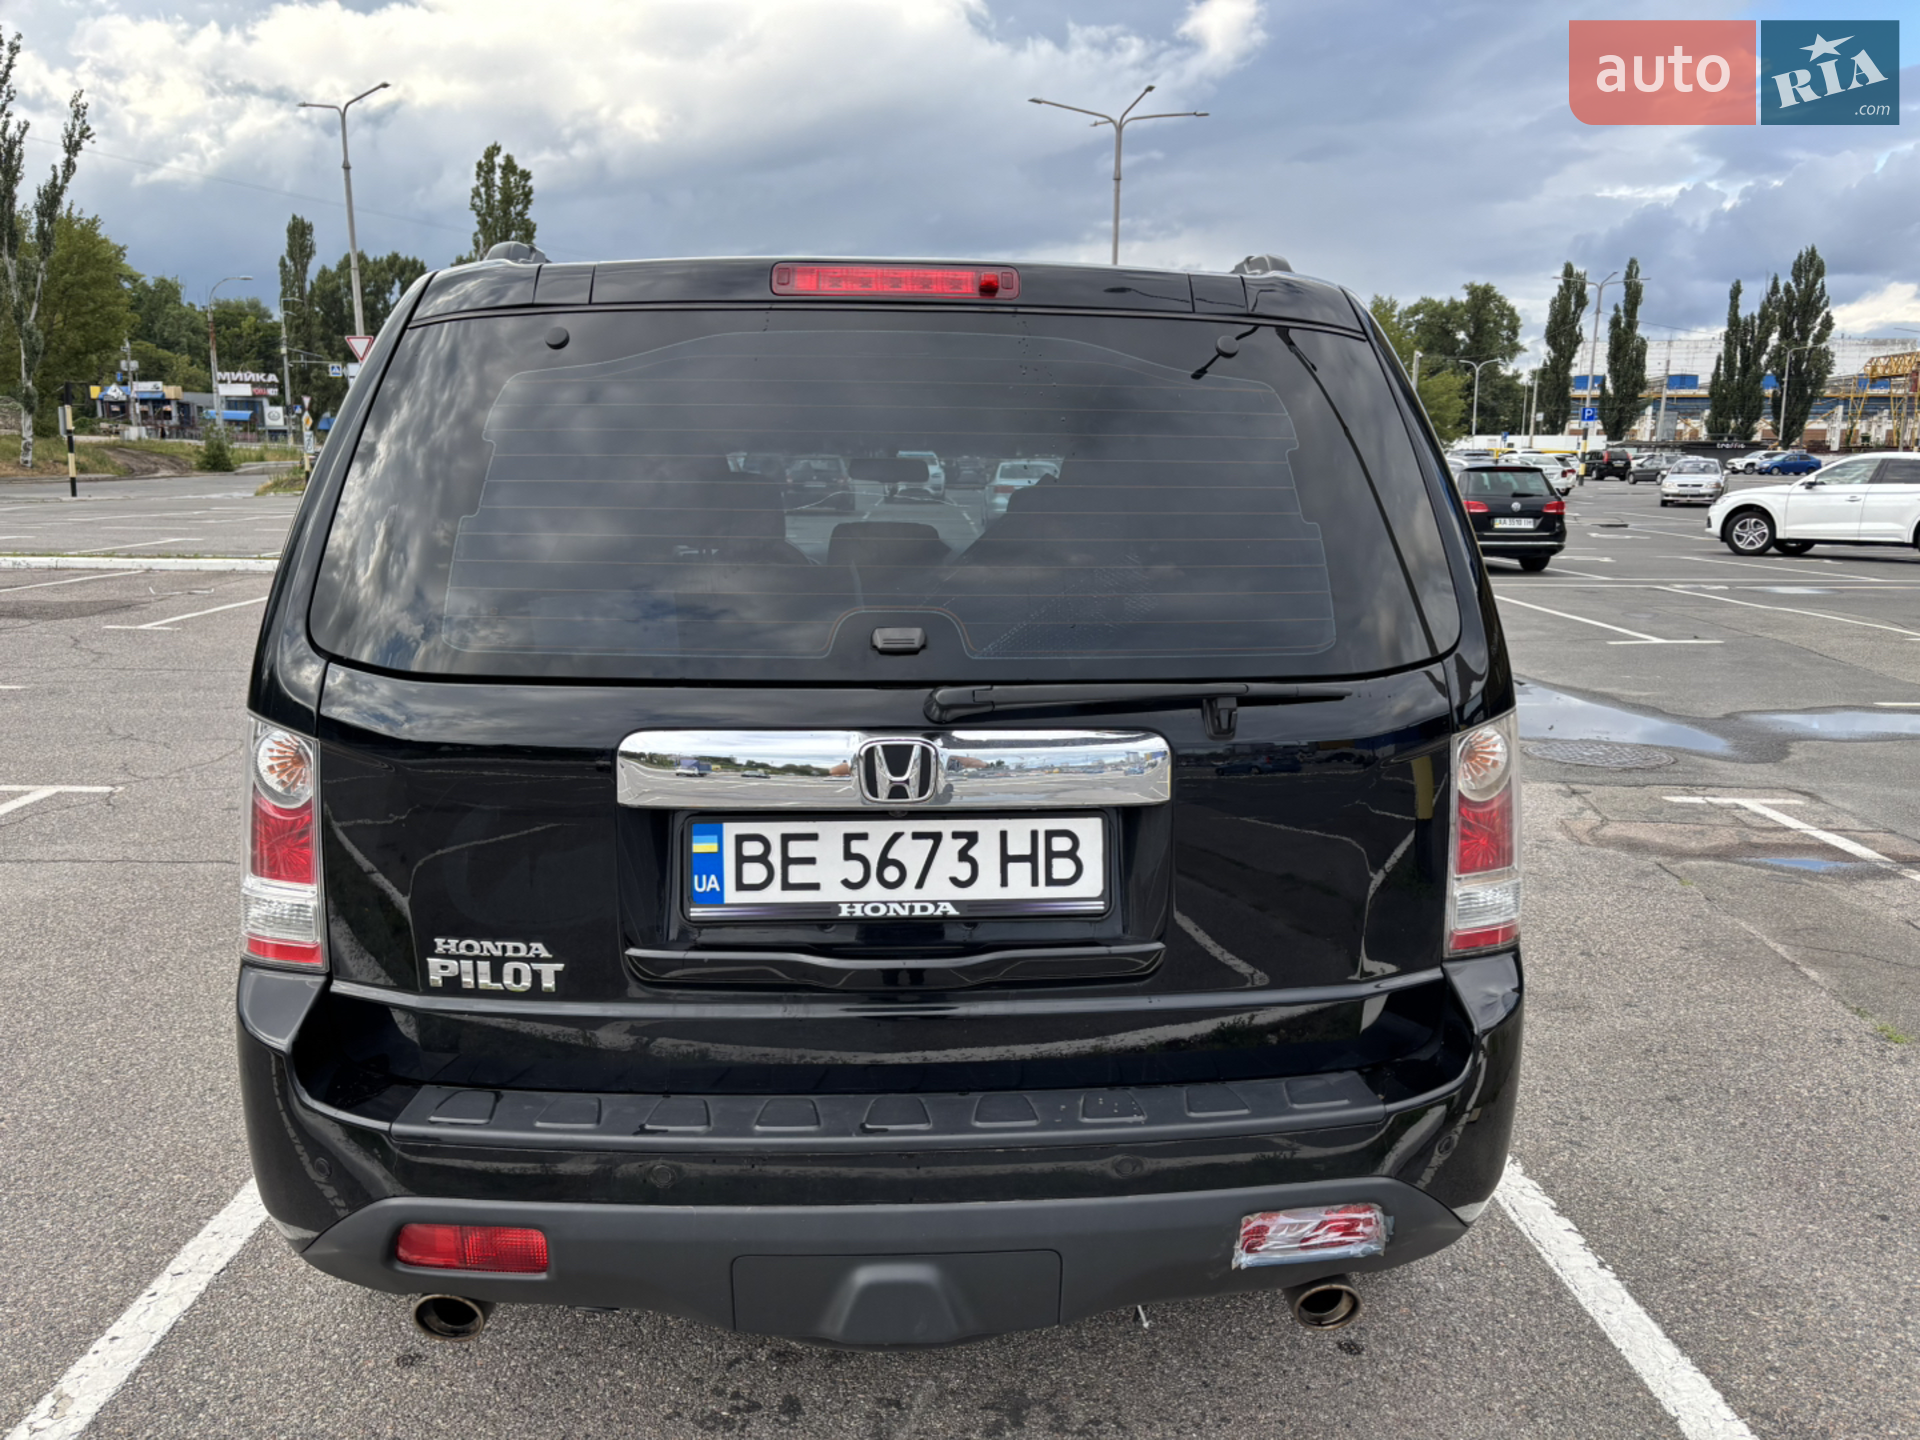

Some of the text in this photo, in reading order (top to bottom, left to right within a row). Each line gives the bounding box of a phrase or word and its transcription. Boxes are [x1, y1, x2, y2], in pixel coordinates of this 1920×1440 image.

[217, 371, 279, 383] МИЙКА
[733, 829, 1084, 892] BE 5673 HB
[693, 873, 720, 893] UA
[838, 901, 960, 917] HONDA
[433, 937, 553, 958] HONDA
[426, 957, 565, 993] PILOT
